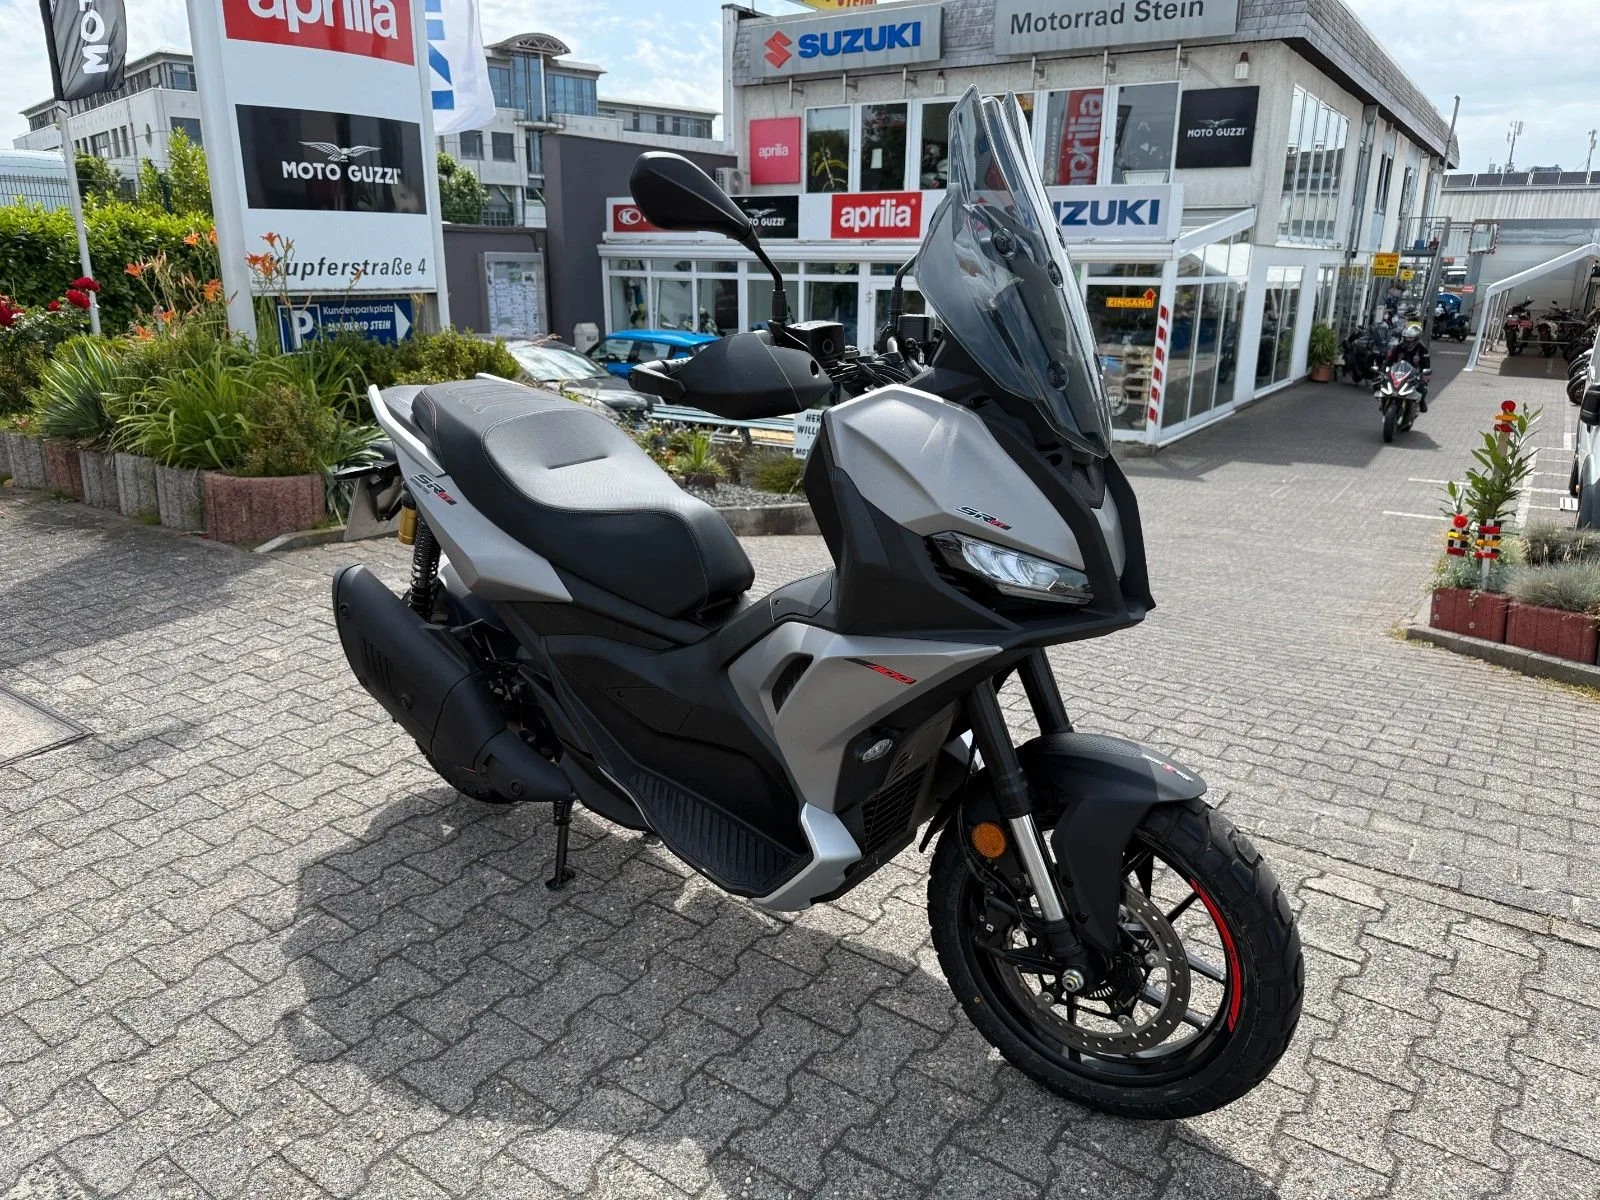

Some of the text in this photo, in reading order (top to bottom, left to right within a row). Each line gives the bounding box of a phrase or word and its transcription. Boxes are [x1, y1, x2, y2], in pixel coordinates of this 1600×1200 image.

[1010, 0, 1204, 35] Motorrad Stein
[798, 21, 921, 58] SUZUKI
[1068, 93, 1104, 185] prilia
[1187, 127, 1245, 138] MOTO GUZZI
[759, 143, 789, 160] aprilia
[281, 160, 399, 184] MOTO GUZZI
[760, 217, 785, 227] GUZZI
[839, 199, 912, 233] aprilia
[418, 258, 426, 275] 4
[322, 305, 394, 315] Kundenparkplatz
[1107, 298, 1152, 307] EINGANG
[291, 310, 314, 350] P
[370, 320, 391, 330] STEIN
